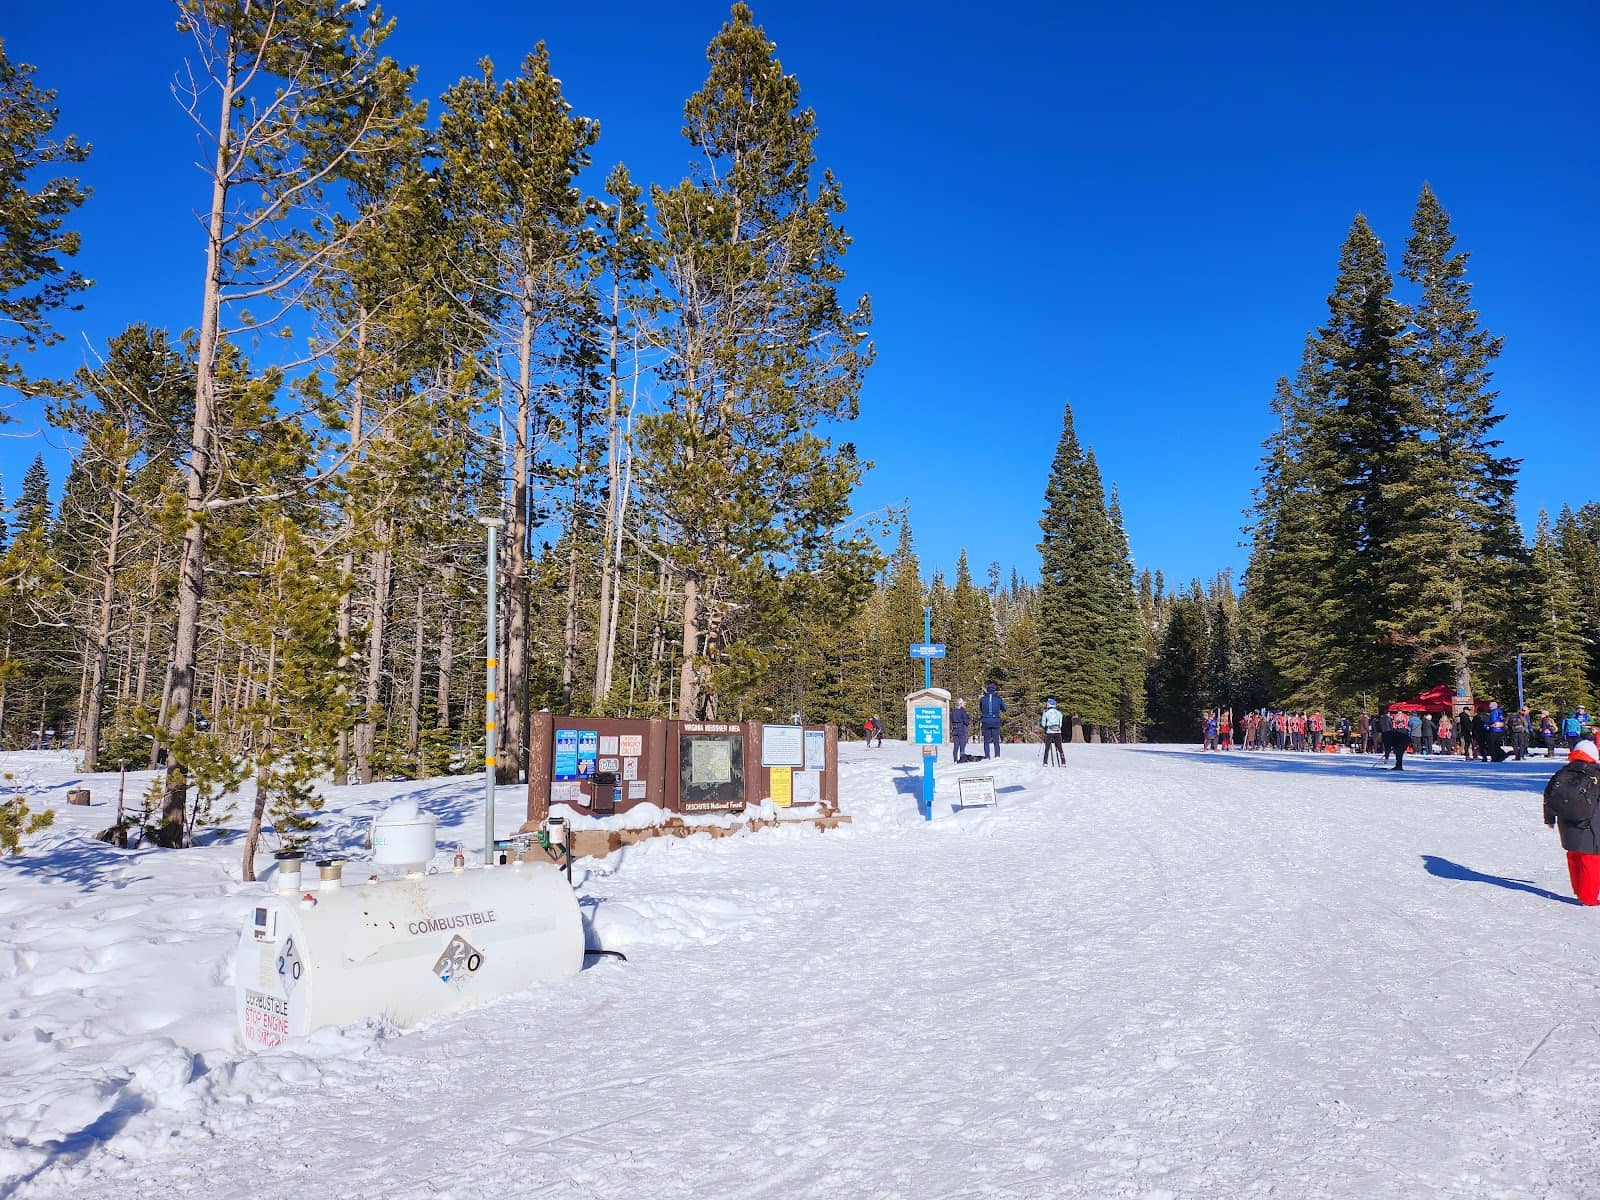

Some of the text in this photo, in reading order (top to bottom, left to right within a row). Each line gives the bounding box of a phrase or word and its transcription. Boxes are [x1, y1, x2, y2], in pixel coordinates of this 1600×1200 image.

[711, 801, 729, 809] National
[729, 801, 743, 809] Forest
[408, 910, 496, 935] COMBUSTIBLE
[286, 937, 293, 957] 2
[452, 940, 465, 959] 2
[279, 955, 286, 975] 2
[440, 958, 452, 977] 2
[245, 1007, 288, 1034] STOP ENGINE
[245, 1023, 255, 1040] NO
